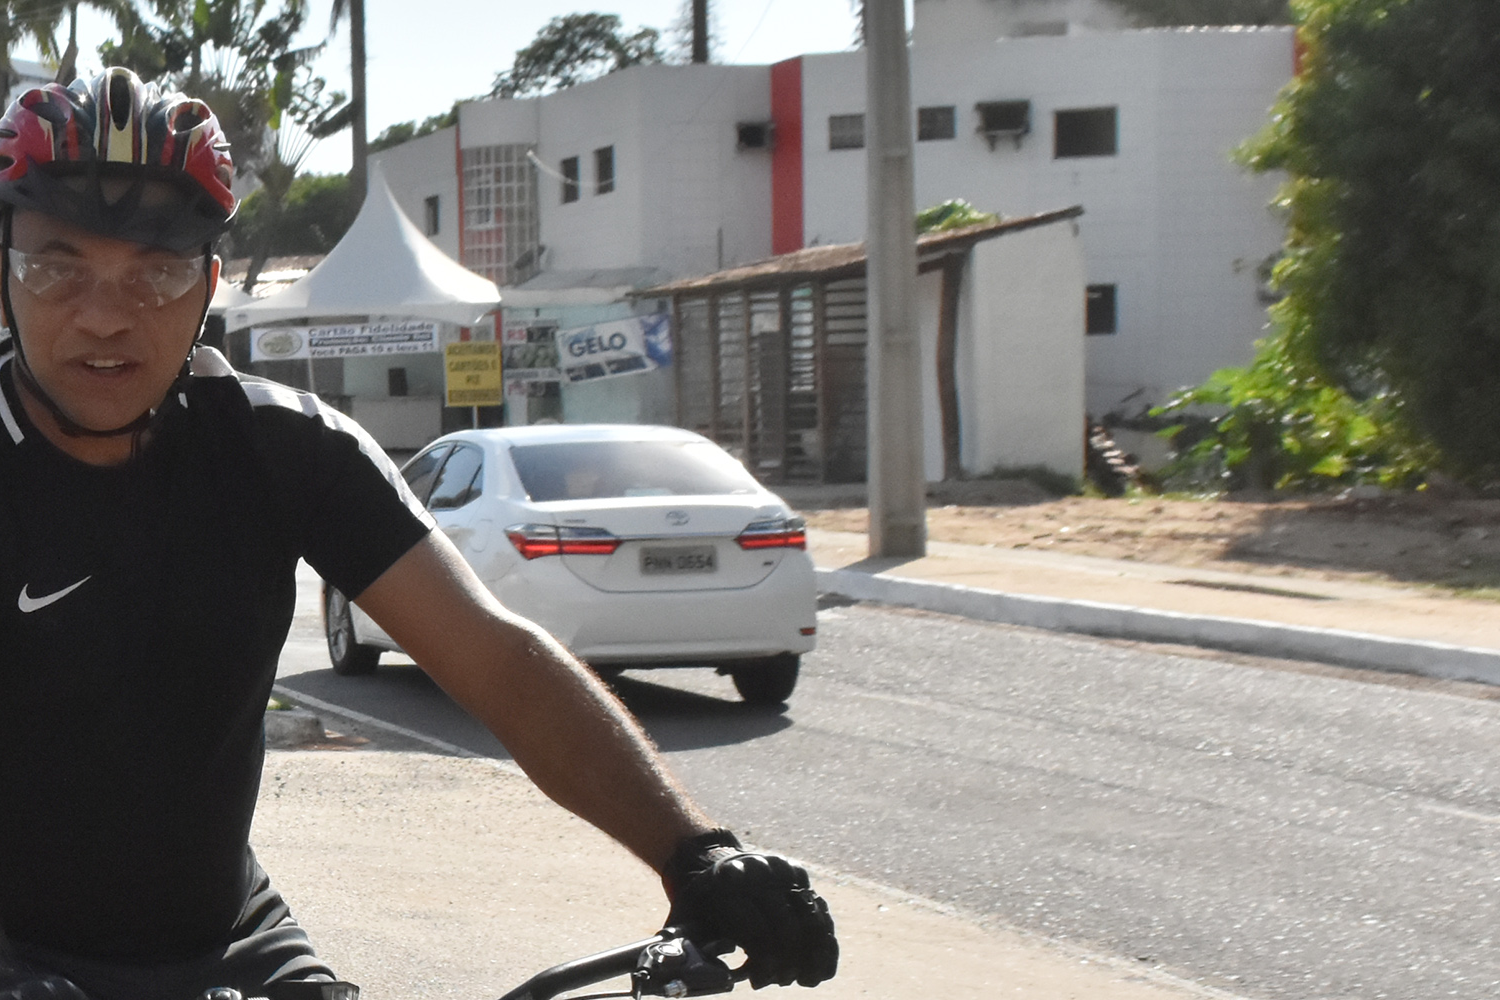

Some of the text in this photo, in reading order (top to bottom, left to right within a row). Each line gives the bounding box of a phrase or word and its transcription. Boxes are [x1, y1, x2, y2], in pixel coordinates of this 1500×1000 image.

[308, 322, 434, 338] Cartão Fidelidade
[339, 345, 367, 355] PAGA
[569, 332, 627, 357] GELO
